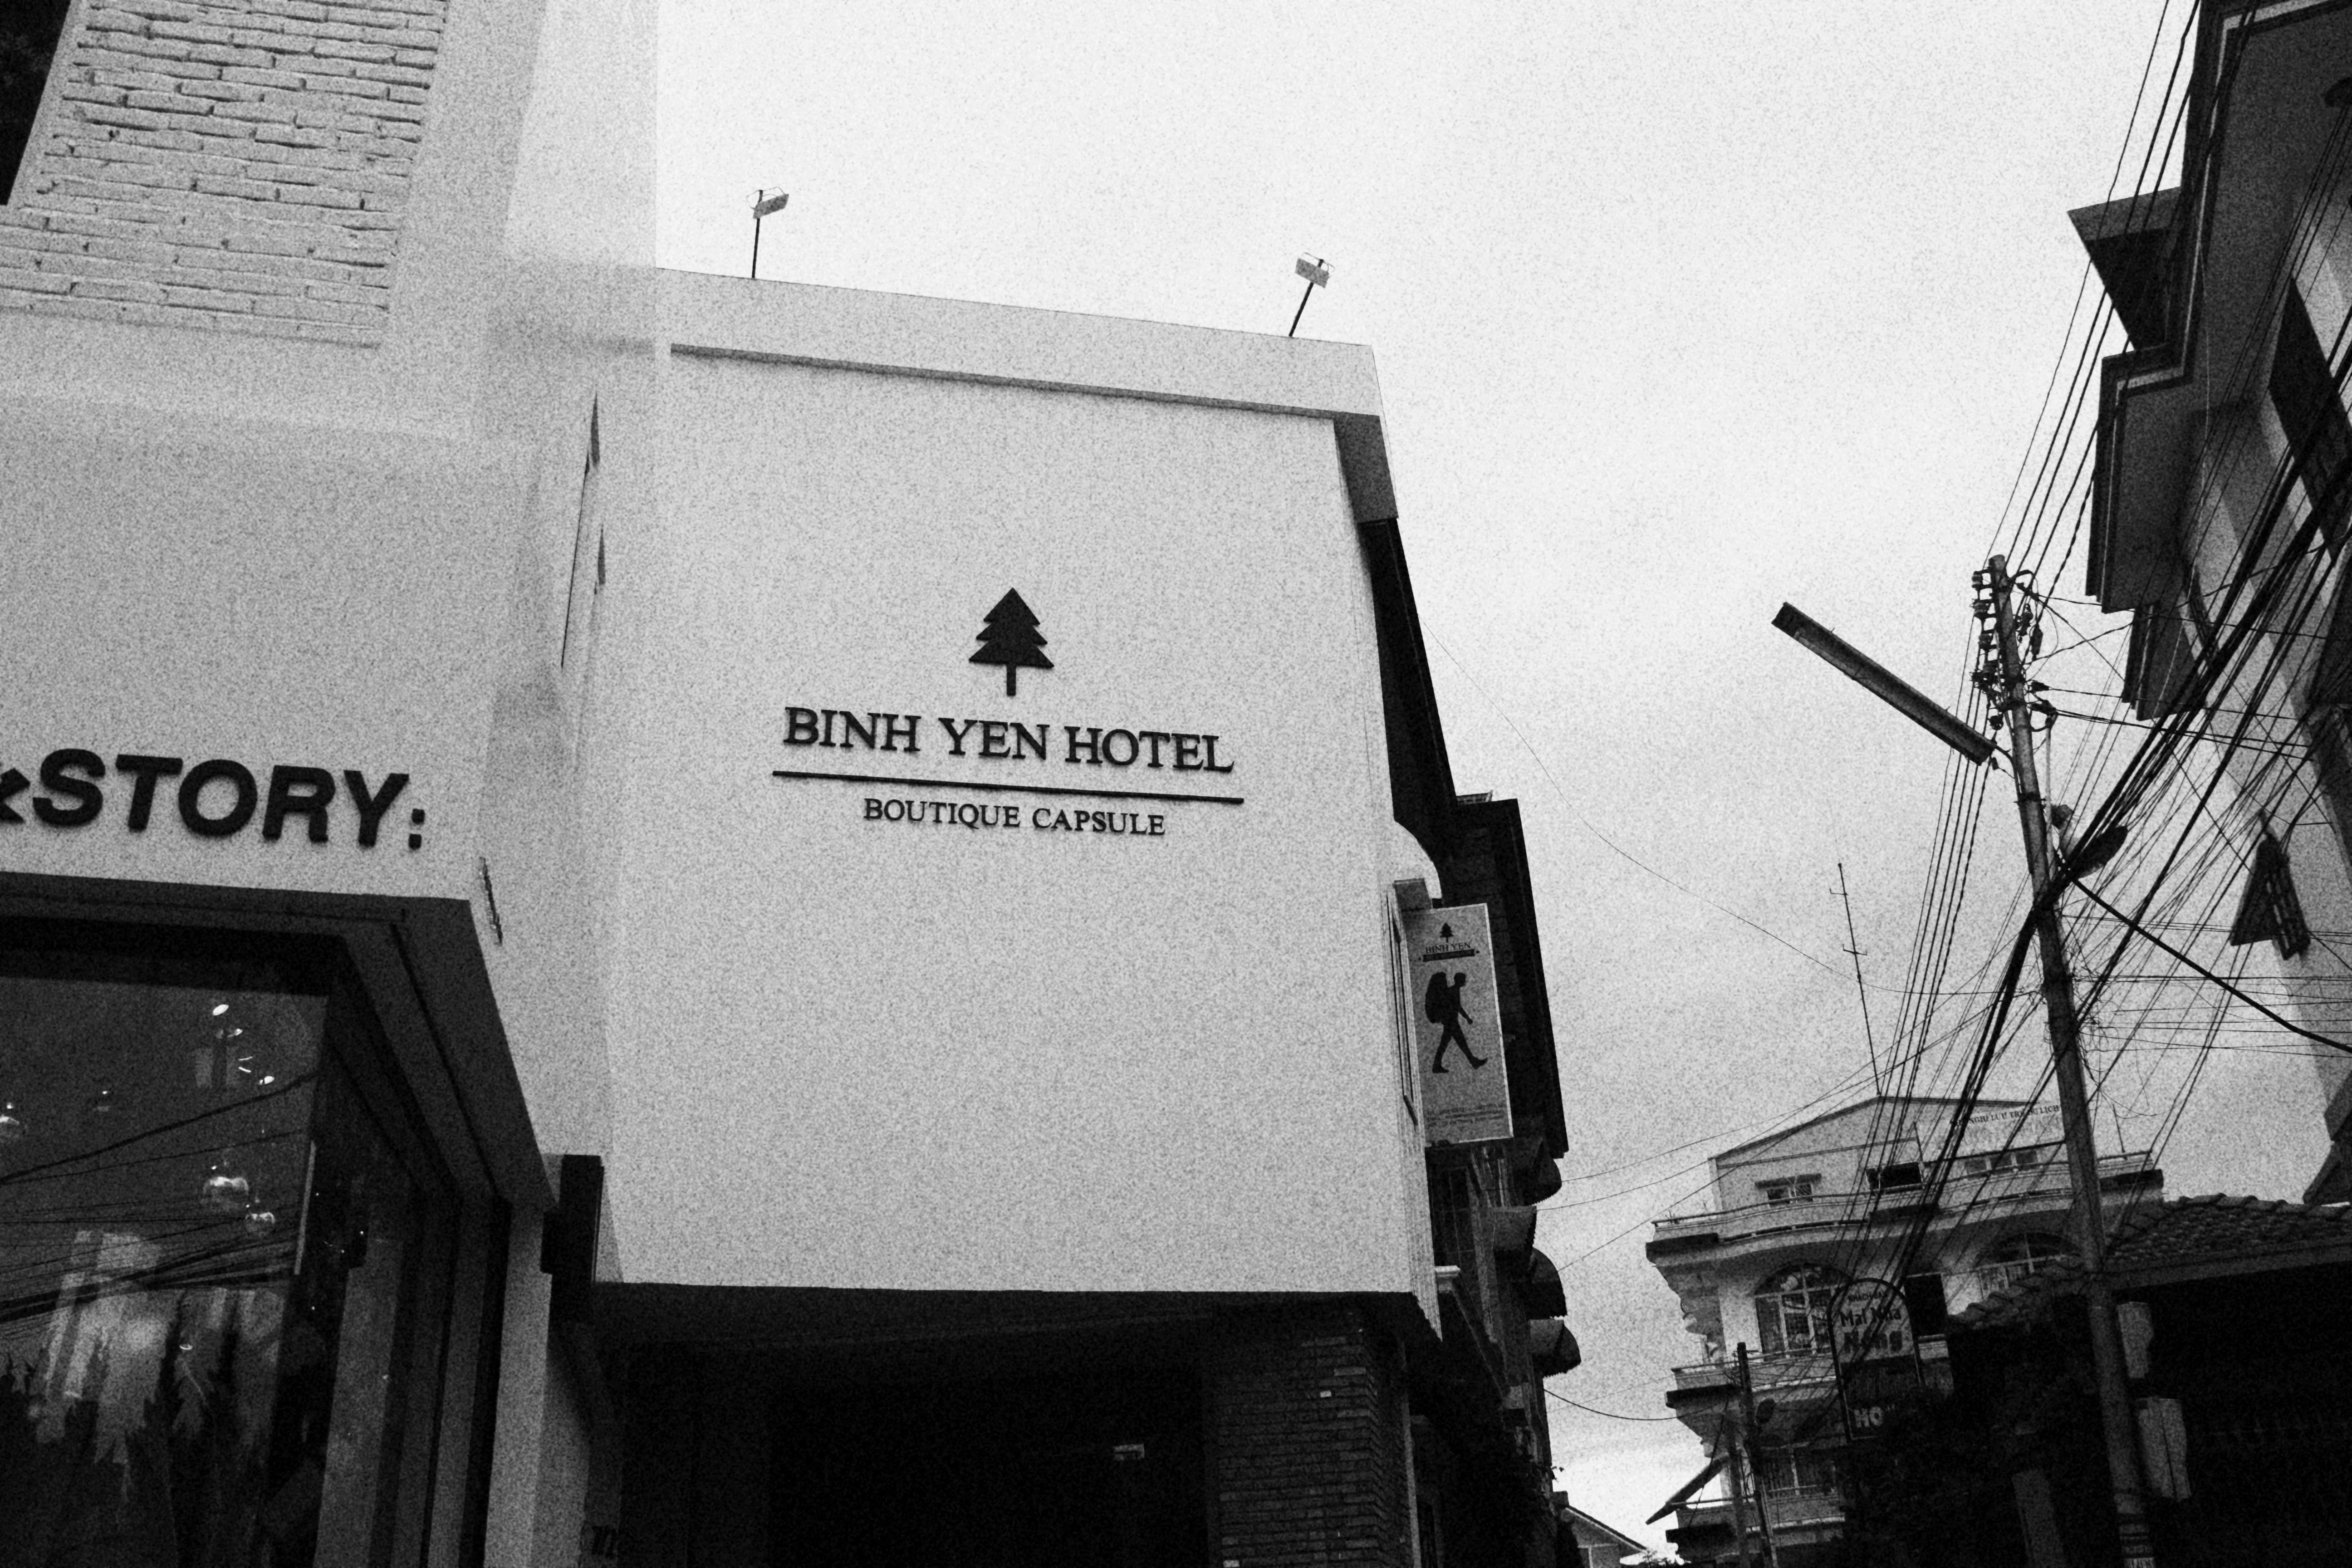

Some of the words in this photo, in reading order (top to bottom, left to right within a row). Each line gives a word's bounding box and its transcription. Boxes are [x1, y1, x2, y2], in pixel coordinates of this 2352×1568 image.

[784, 706, 921, 752] BINH
[939, 718, 1050, 760] YEN
[1065, 725, 1235, 773] HOTEL
[864, 798, 1020, 829] BOUTIQUE
[1032, 807, 1166, 836] CAPSULE
[1426, 944, 1449, 954] BINH
[1451, 942, 1471, 951] YEN
